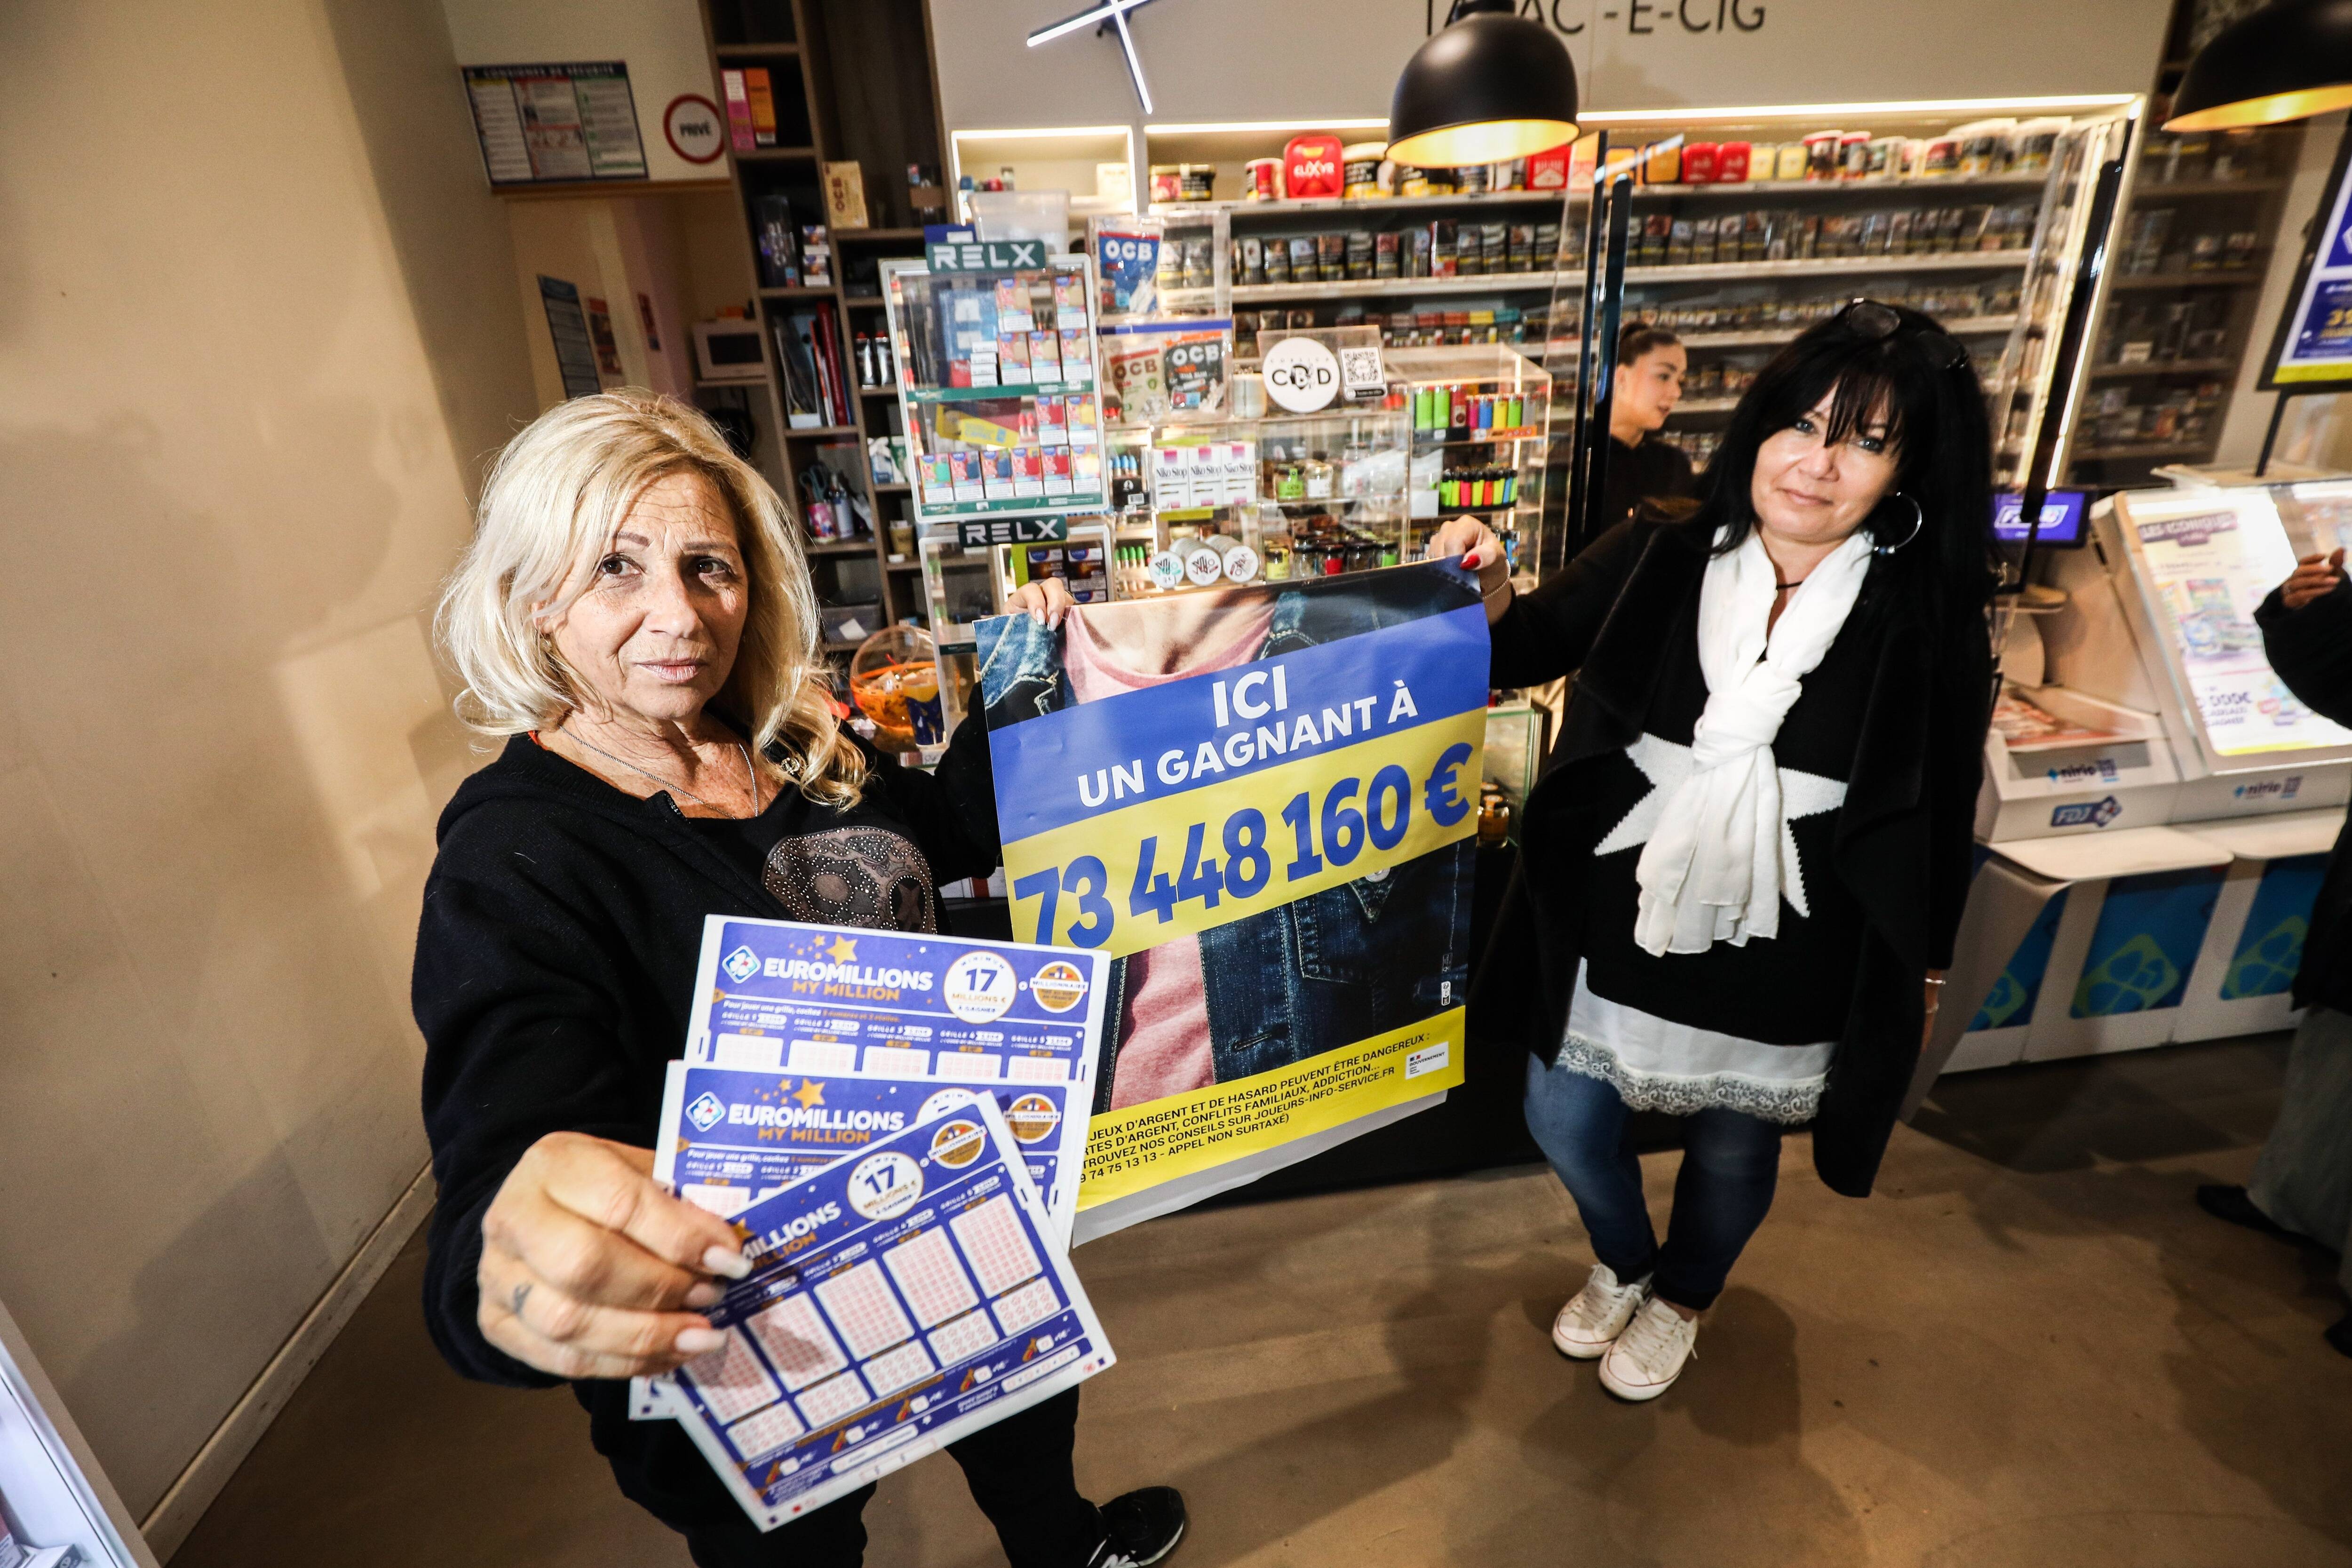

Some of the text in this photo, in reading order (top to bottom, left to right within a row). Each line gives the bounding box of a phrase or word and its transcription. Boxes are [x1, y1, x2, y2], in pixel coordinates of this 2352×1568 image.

[679, 119, 711, 136] PRIVÉ
[933, 244, 1037, 270] RELX
[1105, 239, 1152, 262] OCB
[1172, 344, 1219, 366] OCB
[1114, 358, 1158, 379] OCB
[1172, 468, 1187, 478] Stop
[1207, 466, 1222, 476] Stop
[1240, 463, 1255, 474] Stop
[965, 519, 1059, 544] RELX
[1212, 664, 1287, 728] ICI
[1077, 679, 1419, 808] UN GAGNANT À
[1013, 742, 1474, 948] 73 448 160 €
[763, 956, 933, 992] EUROMILLIONS
[966, 968, 998, 992] 17
[792, 980, 900, 1002] MY MILLION
[952, 993, 998, 1003] MILLIONS
[723, 1000, 741, 1009] Pour
[1409, 1051, 1445, 1067] GOUVERNEMENT
[1089, 1124, 1122, 1141] JEUX
[1127, 1106, 1188, 1131] D'ARGENT
[1191, 1102, 1206, 1114] ET
[1209, 1098, 1225, 1109] DE
[1228, 1084, 1277, 1105] HASARD
[1280, 1066, 1331, 1089] PEUVENT
[1334, 1056, 1359, 1073] ÊTRE
[1363, 1033, 1424, 1062] DANGEREUX
[728, 1103, 905, 1131] EUROMILLIONS
[1116, 1121, 1179, 1147] D'ARGENT,
[1183, 1105, 1241, 1127] CONFLITS
[1245, 1084, 1310, 1111] FAMILIAUX,
[1312, 1064, 1380, 1090] ADDICTION...
[1083, 1067, 1395, 1169] TROUVEZ NOS CONSEILS SUR JOUEURS-INFO-SERVICE.FR
[758, 1127, 871, 1144] MY MILLION
[1089, 1168, 1105, 1180] 74
[1107, 1163, 1122, 1174] 75
[1126, 1158, 1140, 1169] 13
[1144, 1152, 1157, 1163] 13
[1168, 1138, 1205, 1156] APPEL
[1208, 1130, 1233, 1145] NON
[1236, 1114, 1290, 1136] SURTAXÉ)
[865, 1165, 896, 1194] 17
[863, 1183, 911, 1210] MILLIONS
